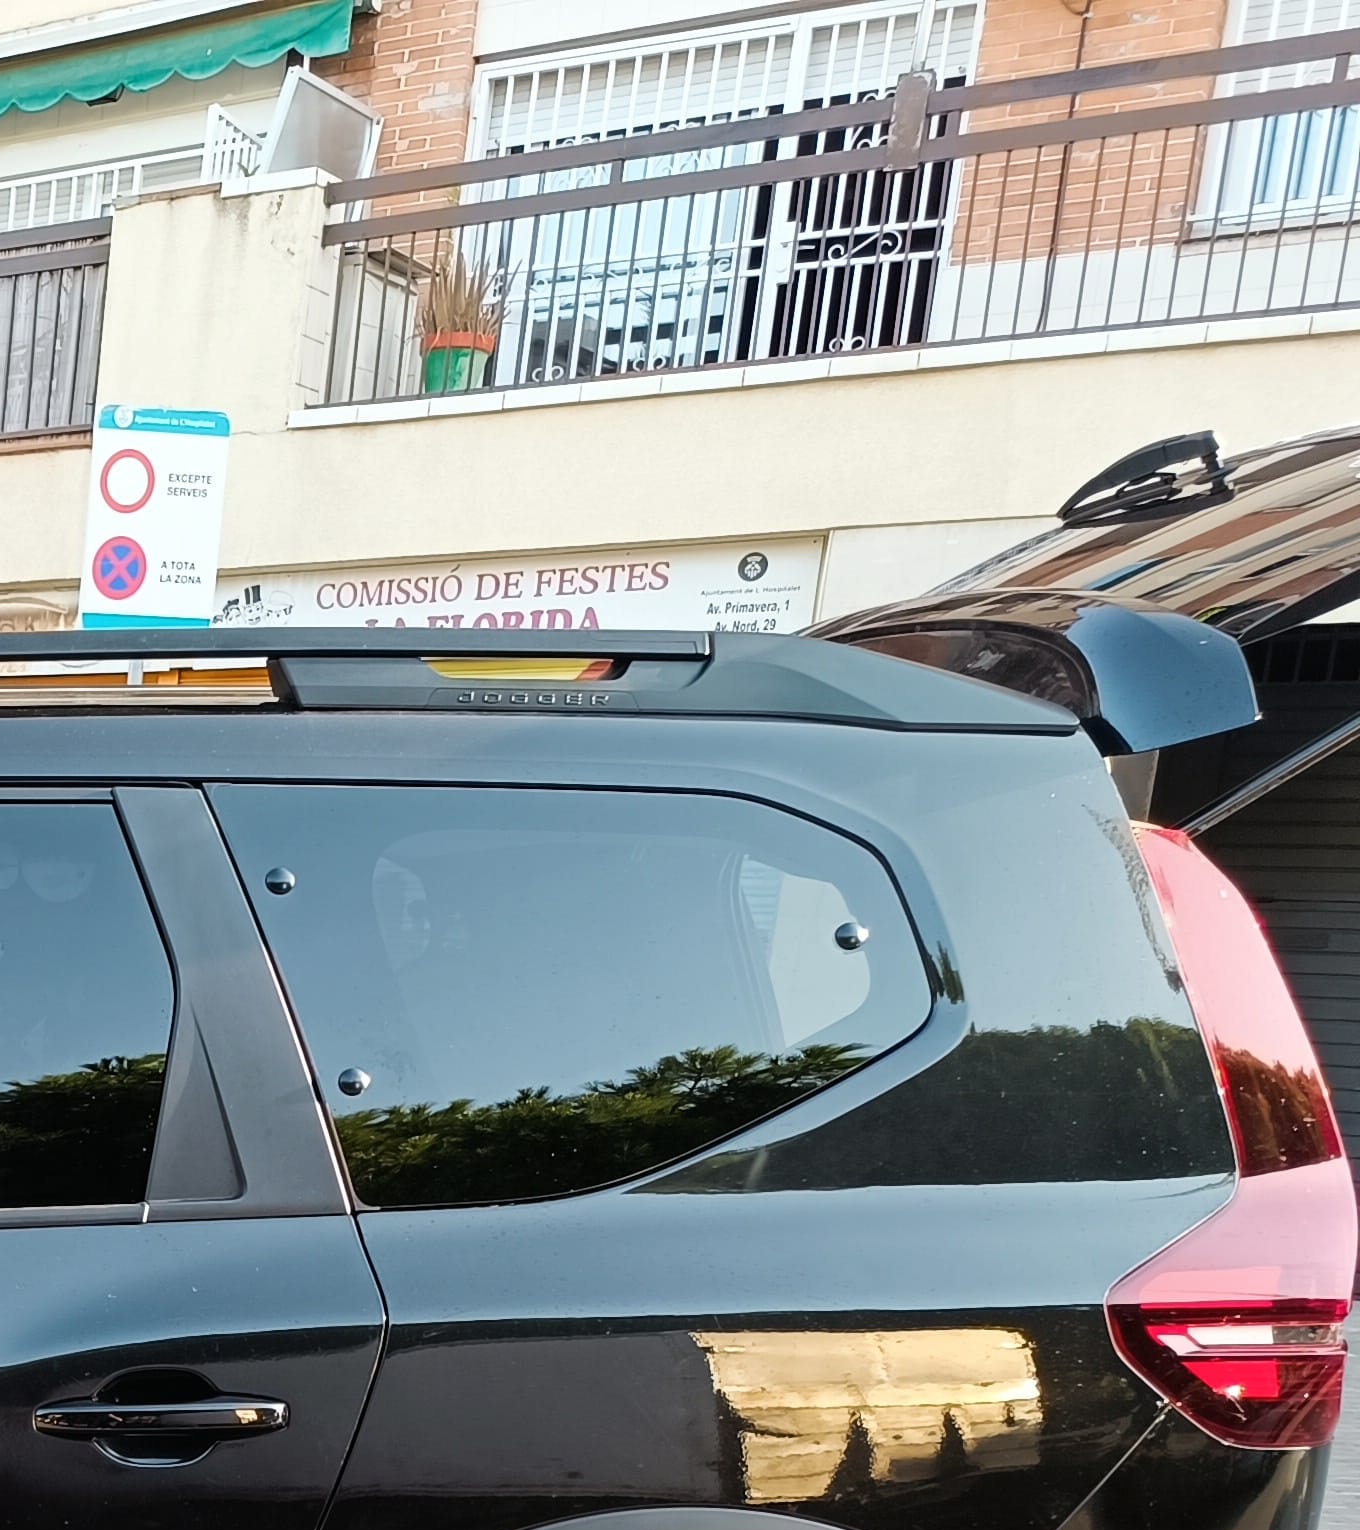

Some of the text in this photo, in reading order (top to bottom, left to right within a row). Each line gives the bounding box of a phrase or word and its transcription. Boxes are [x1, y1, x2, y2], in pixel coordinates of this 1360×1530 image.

[168, 473, 213, 485] EXCEPTE
[167, 487, 208, 498] SERVEIS
[161, 561, 196, 570] A TOTA
[160, 574, 202, 584] LA ZONA
[316, 561, 671, 610] COMISSIÓ DE FESTES
[707, 599, 790, 615] Av. Primavera, 1
[763, 618, 777, 631] 29
[457, 691, 610, 705] JOGGER
